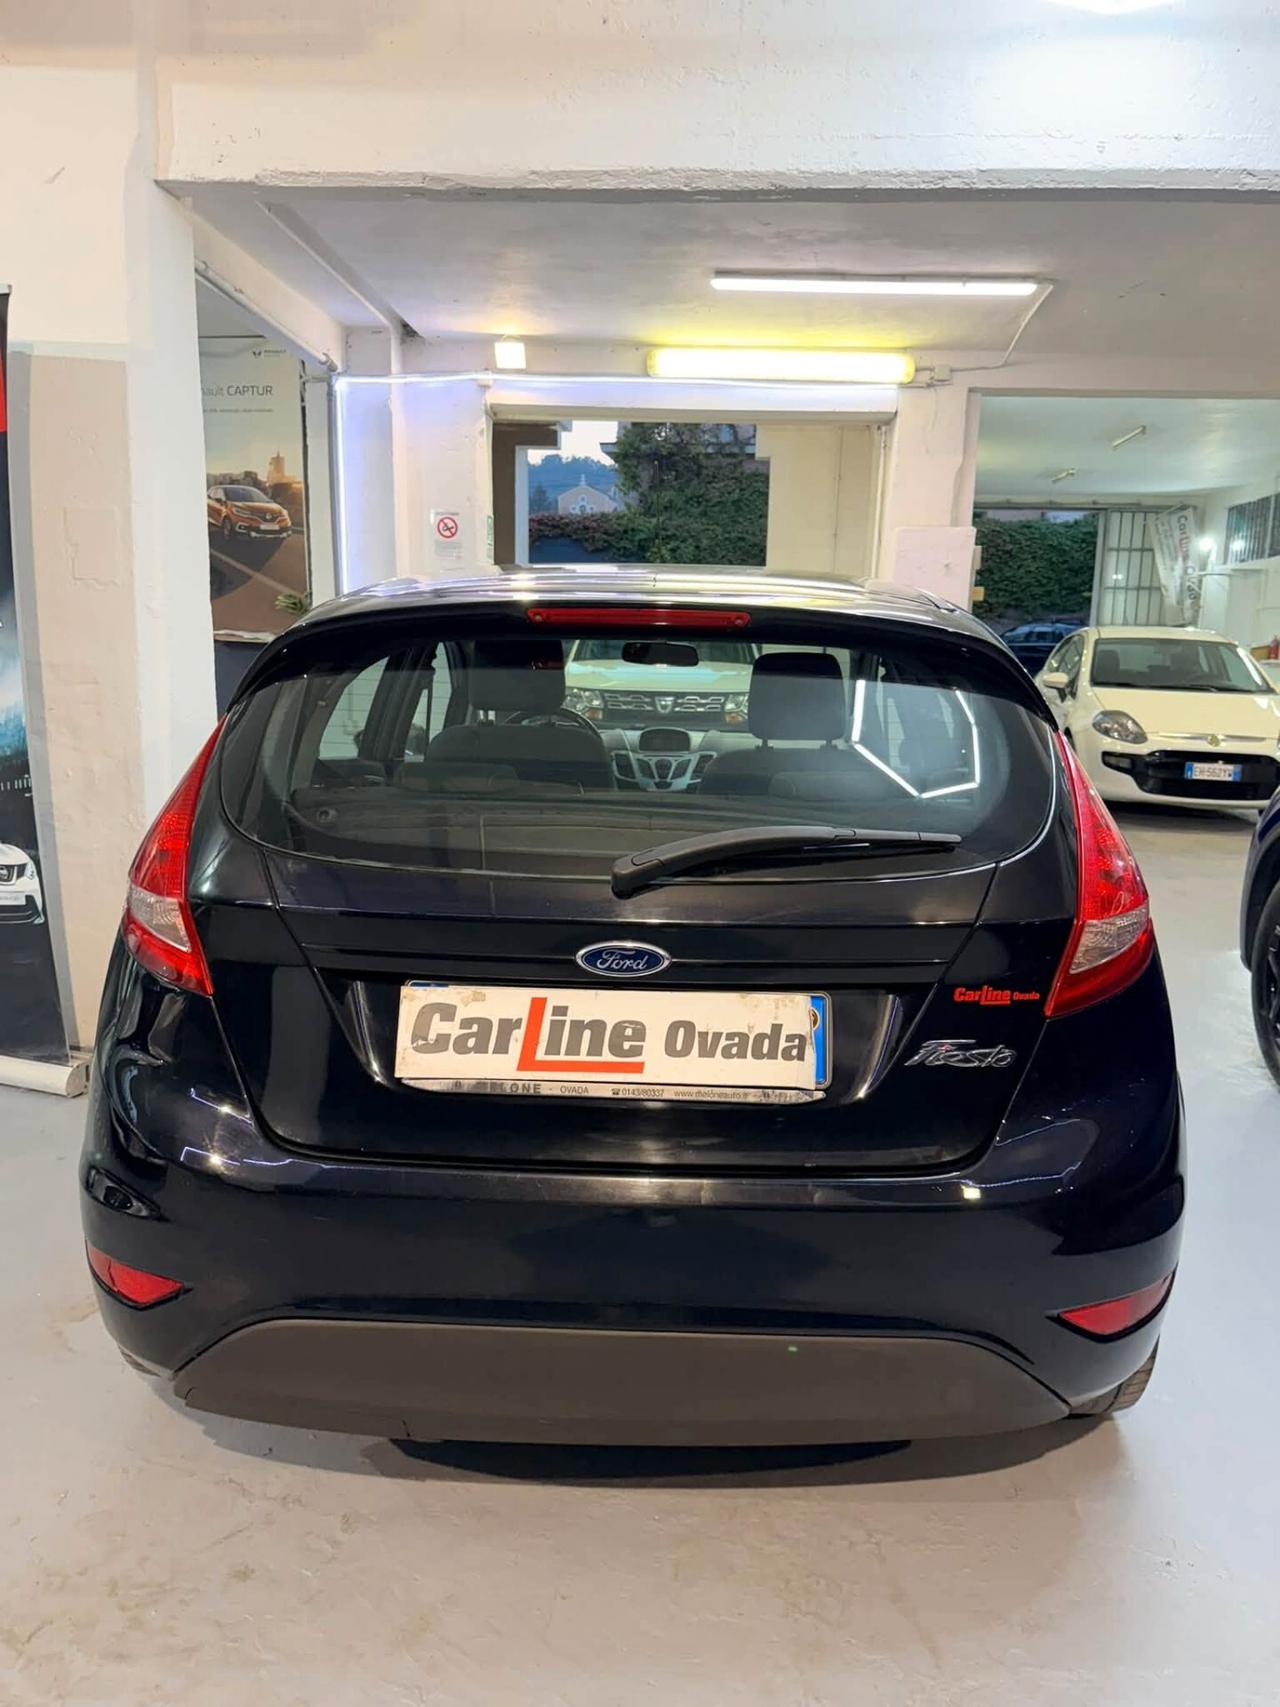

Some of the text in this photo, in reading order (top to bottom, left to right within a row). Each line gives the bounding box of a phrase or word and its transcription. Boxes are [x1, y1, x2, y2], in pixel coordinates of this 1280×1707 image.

[226, 385, 273, 396] CAPTUR
[596, 949, 649, 970] Ford
[664, 1020, 808, 1062] Ovada
[559, 1085, 589, 1095] OVADA
